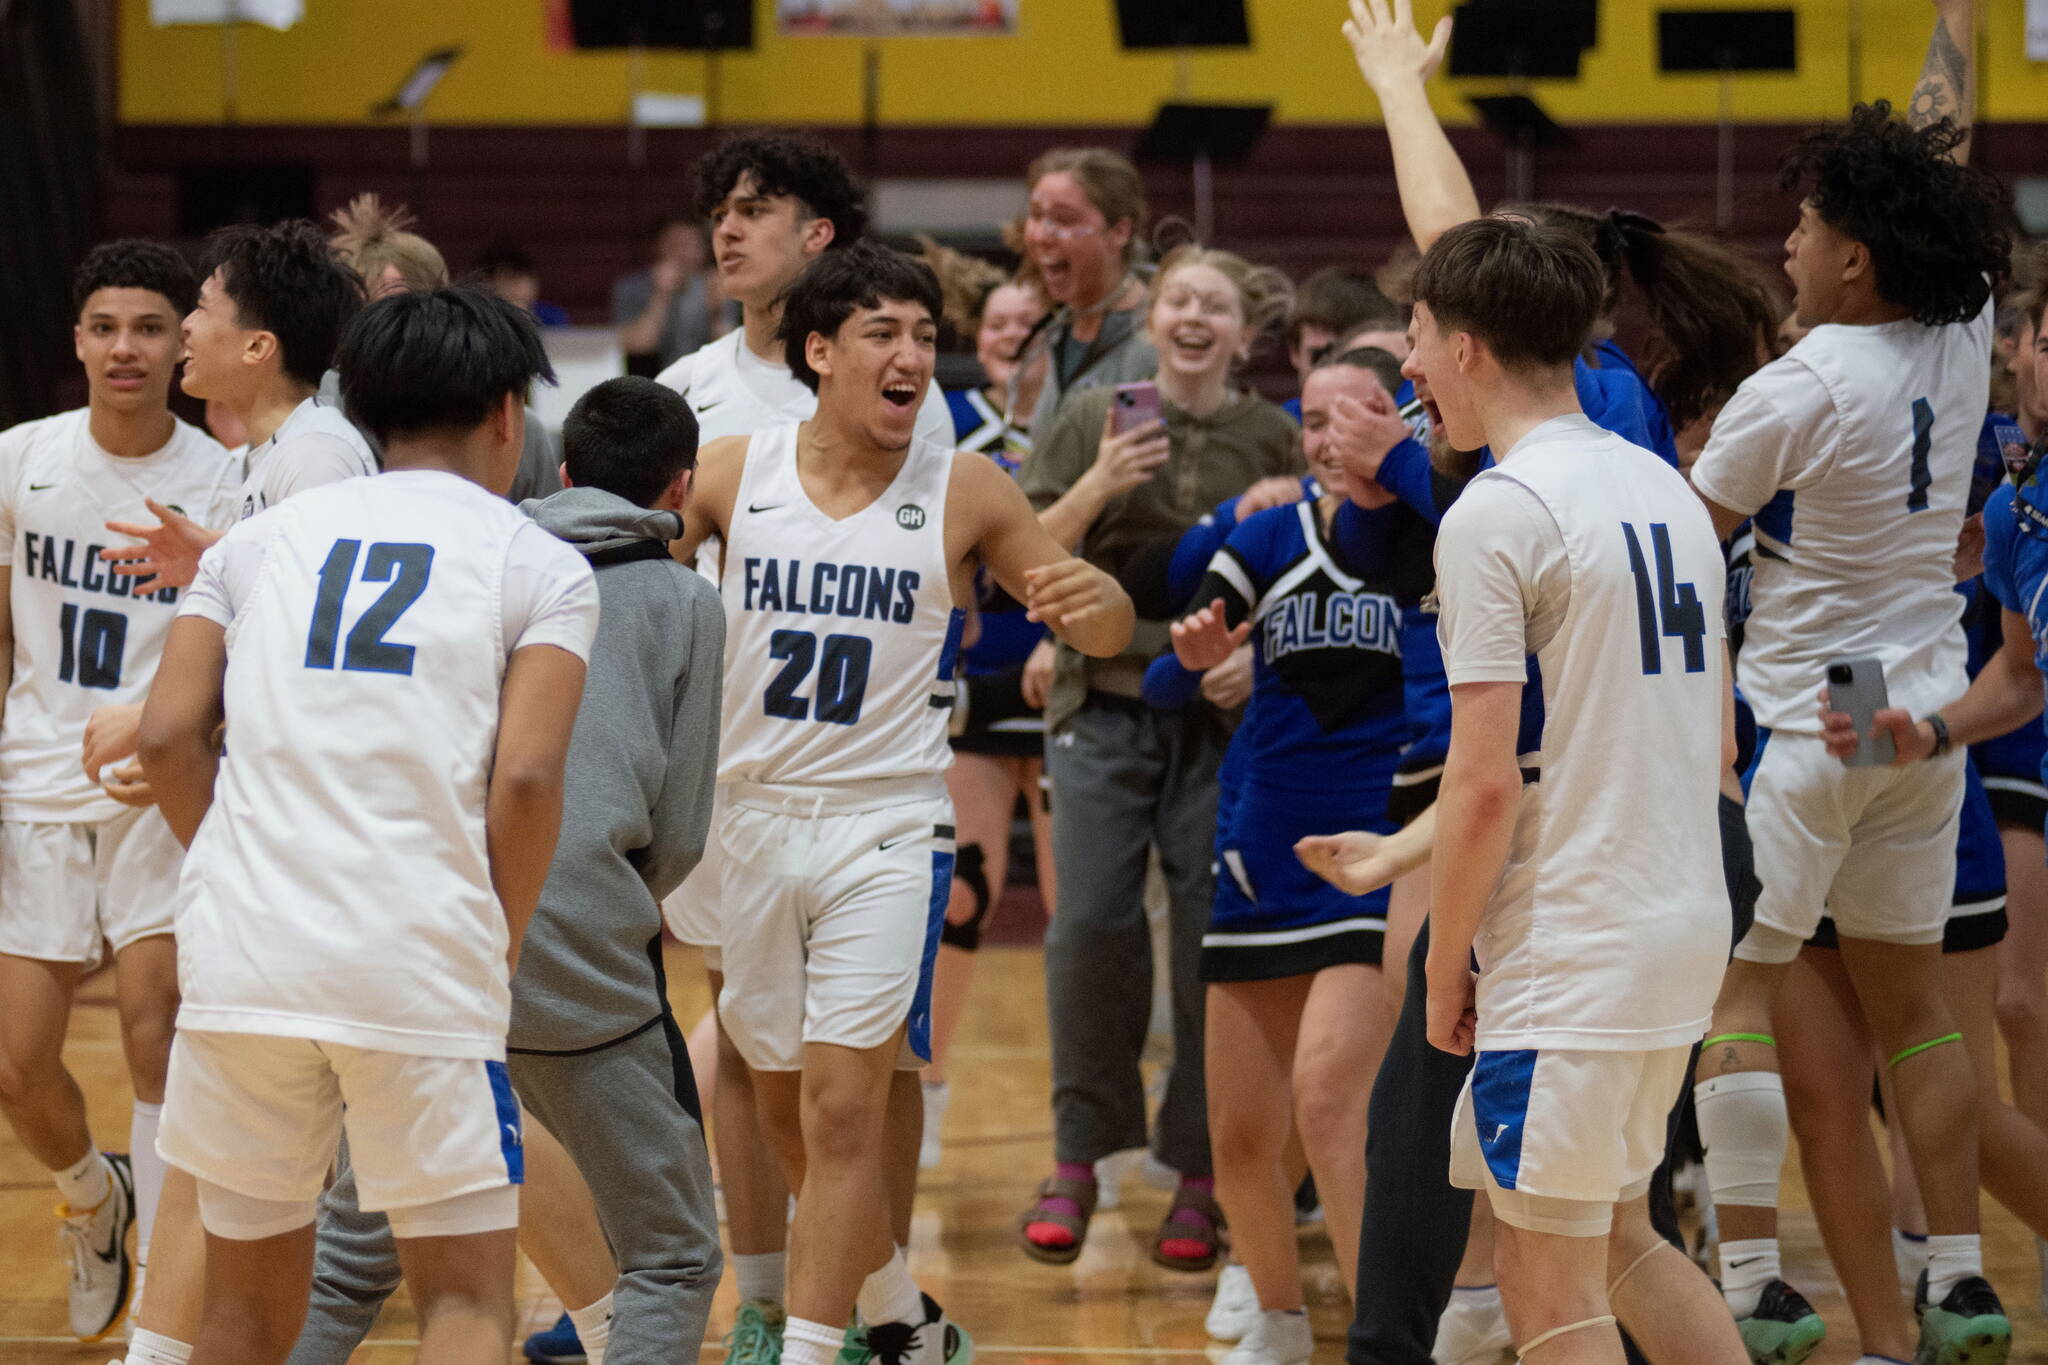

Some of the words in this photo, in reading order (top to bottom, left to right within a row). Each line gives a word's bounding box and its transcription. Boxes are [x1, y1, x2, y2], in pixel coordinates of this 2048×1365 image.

[1907, 397, 1935, 513] 1
[899, 508, 924, 526] GH
[304, 538, 435, 676] 12
[744, 558, 920, 625] FALCONS
[1621, 522, 1706, 675] 14
[58, 602, 128, 690] 10
[764, 629, 872, 725] 20
